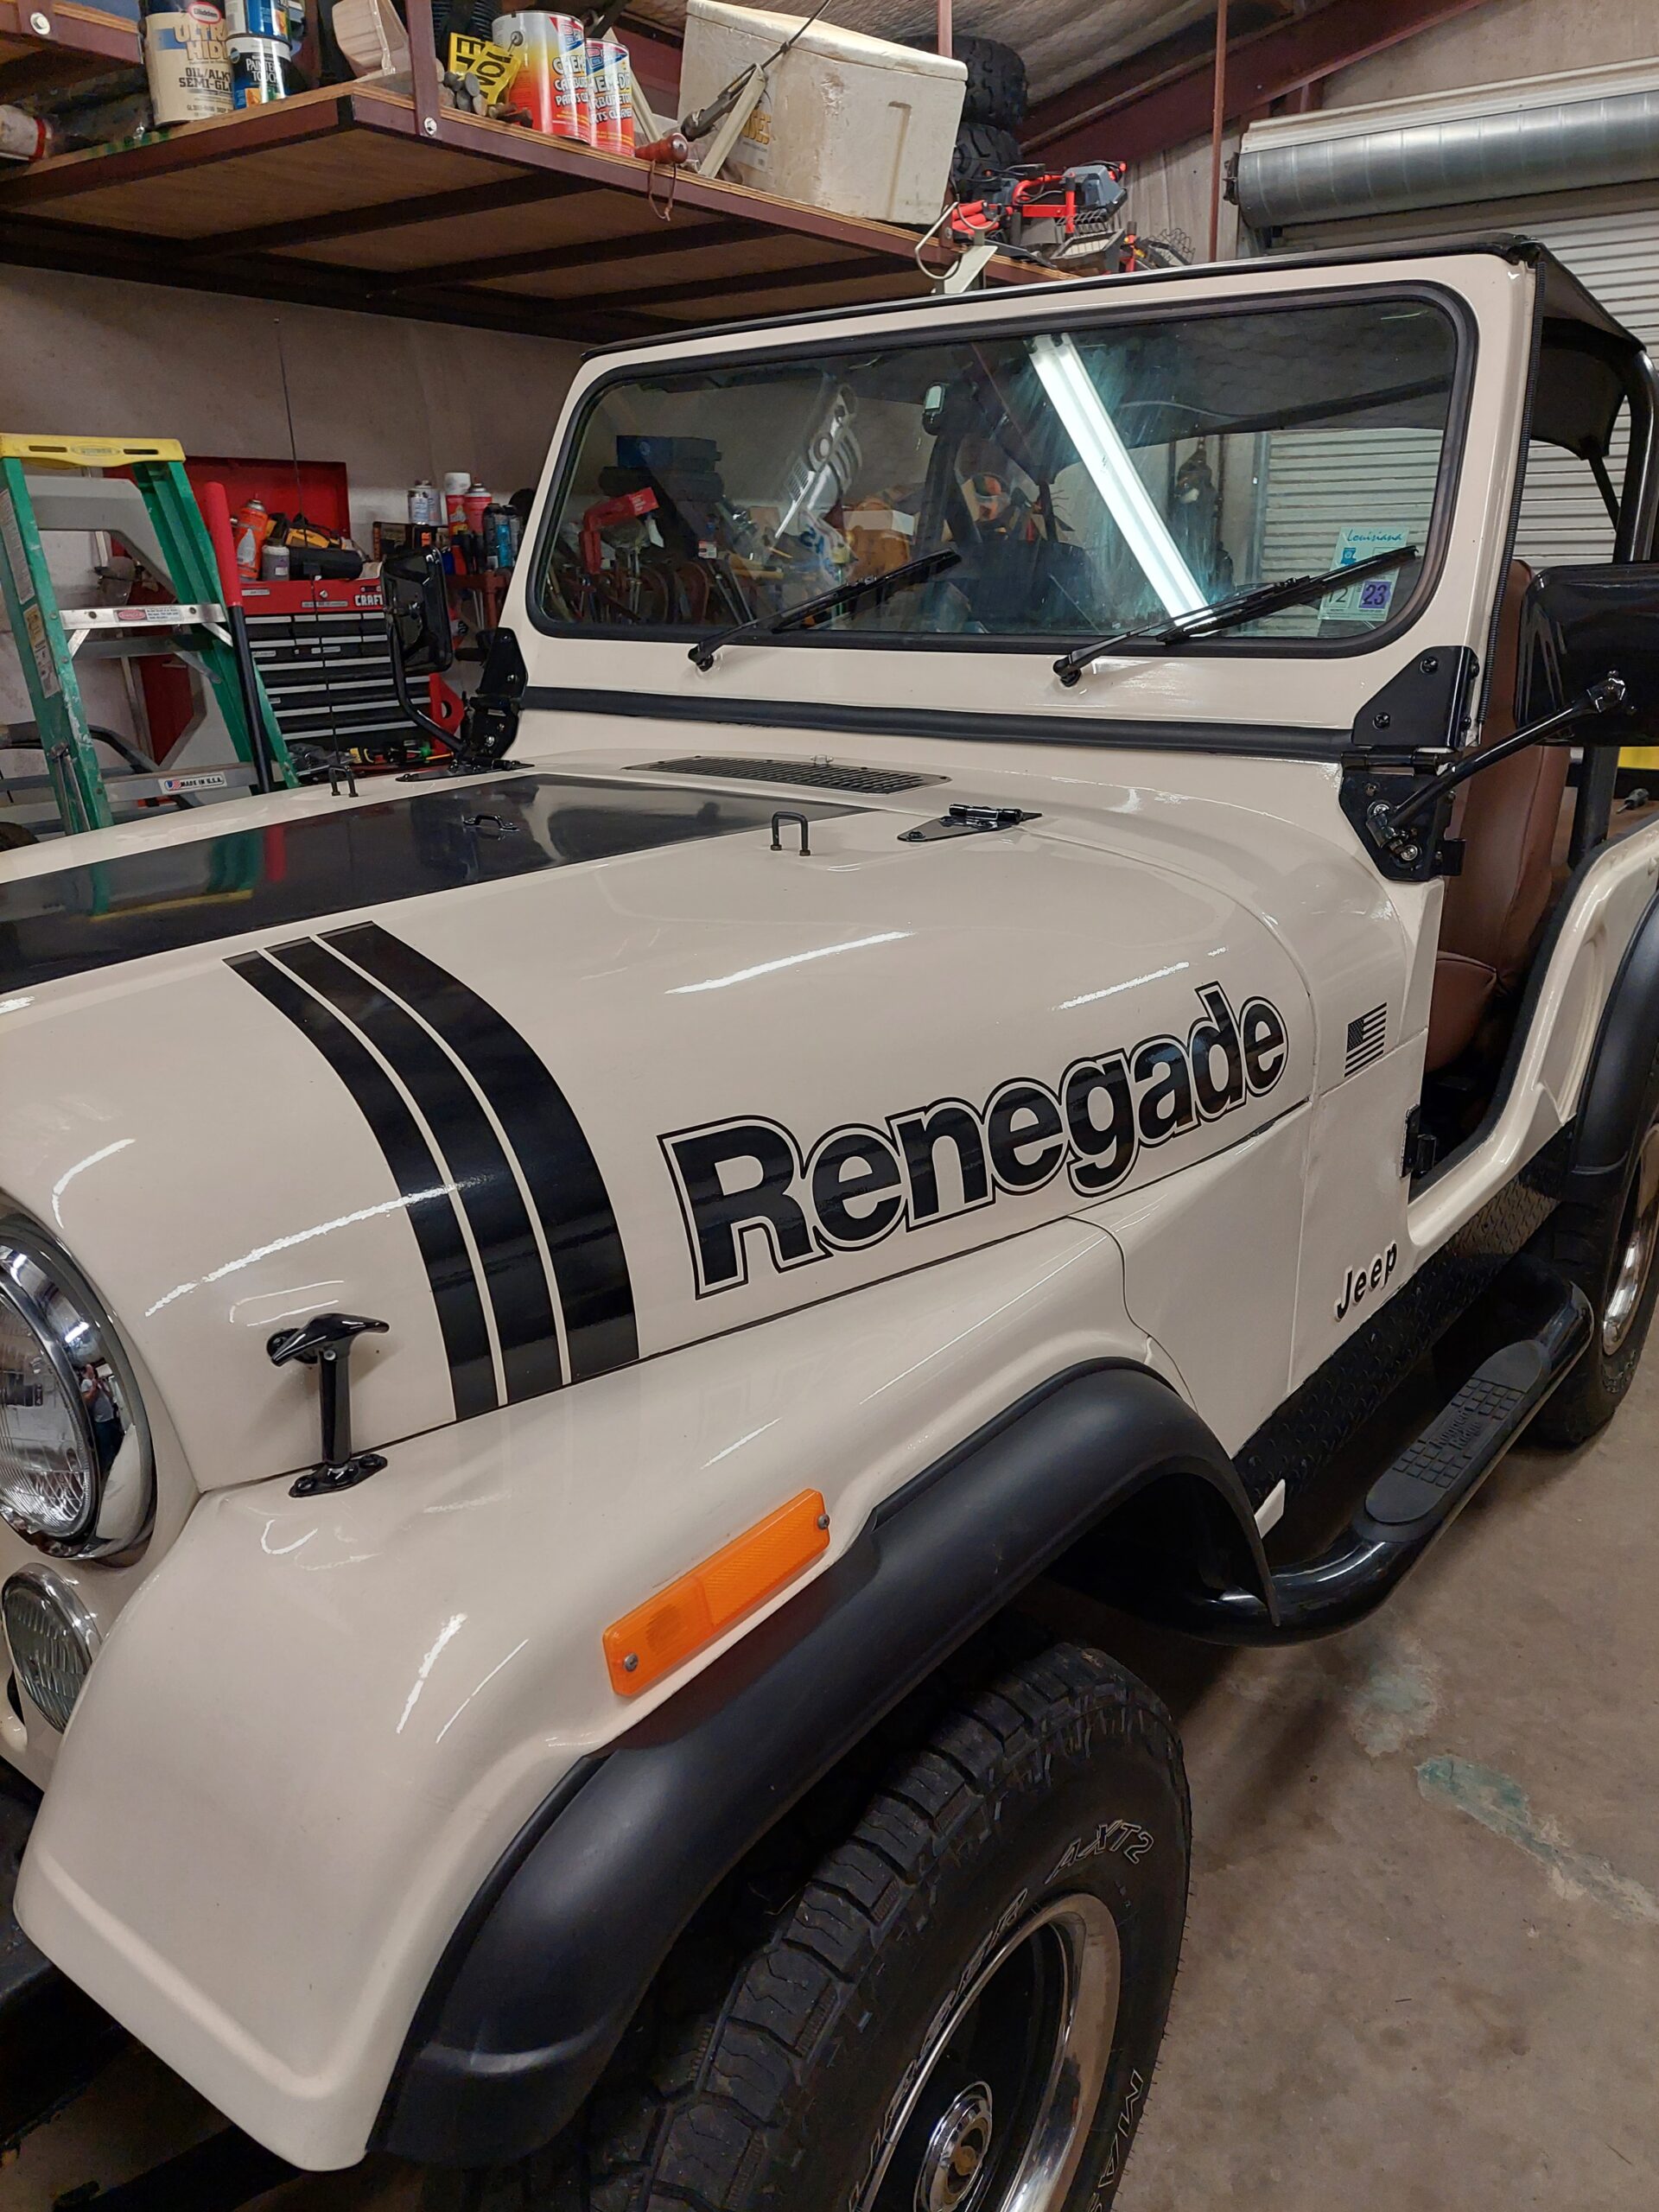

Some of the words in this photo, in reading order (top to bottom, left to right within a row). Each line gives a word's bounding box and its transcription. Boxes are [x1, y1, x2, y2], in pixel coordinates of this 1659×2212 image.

[1347, 529, 1402, 543] Louisiana
[1362, 584, 1388, 606] 23
[657, 981, 1289, 1300] Renegade
[1335, 1241, 1398, 1321] Jeep
